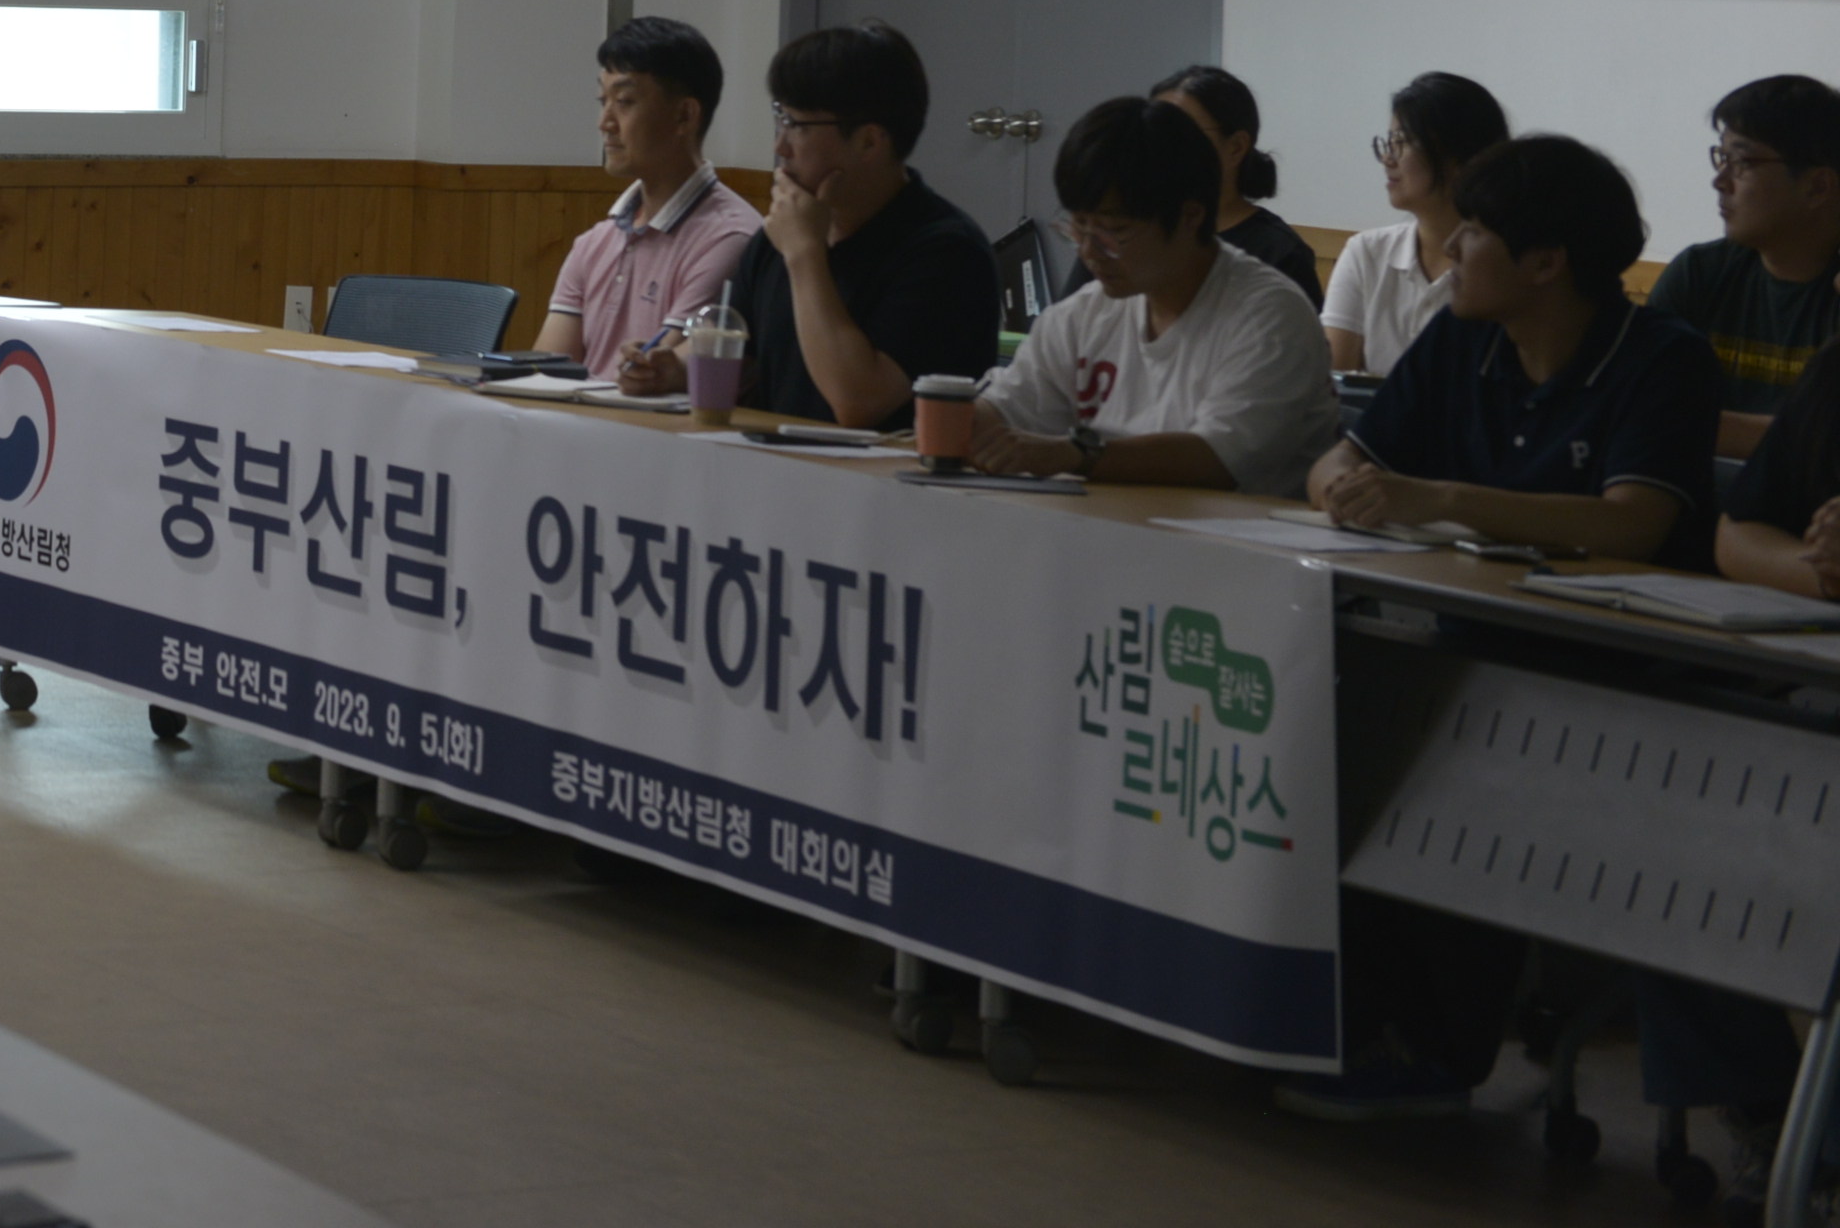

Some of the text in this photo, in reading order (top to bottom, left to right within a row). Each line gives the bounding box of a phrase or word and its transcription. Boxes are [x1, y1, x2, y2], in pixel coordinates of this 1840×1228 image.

[1569, 439, 1592, 469] P
[158, 417, 924, 743] 중부산림, 안전하자!
[161, 635, 204, 687] 중부
[314, 680, 374, 738] 2023.
[386, 703, 406, 749] 9.
[1075, 604, 1155, 738] 산림
[551, 751, 894, 907] 중부지방산림청 대회의실
[1114, 703, 1294, 862] 르네상스
